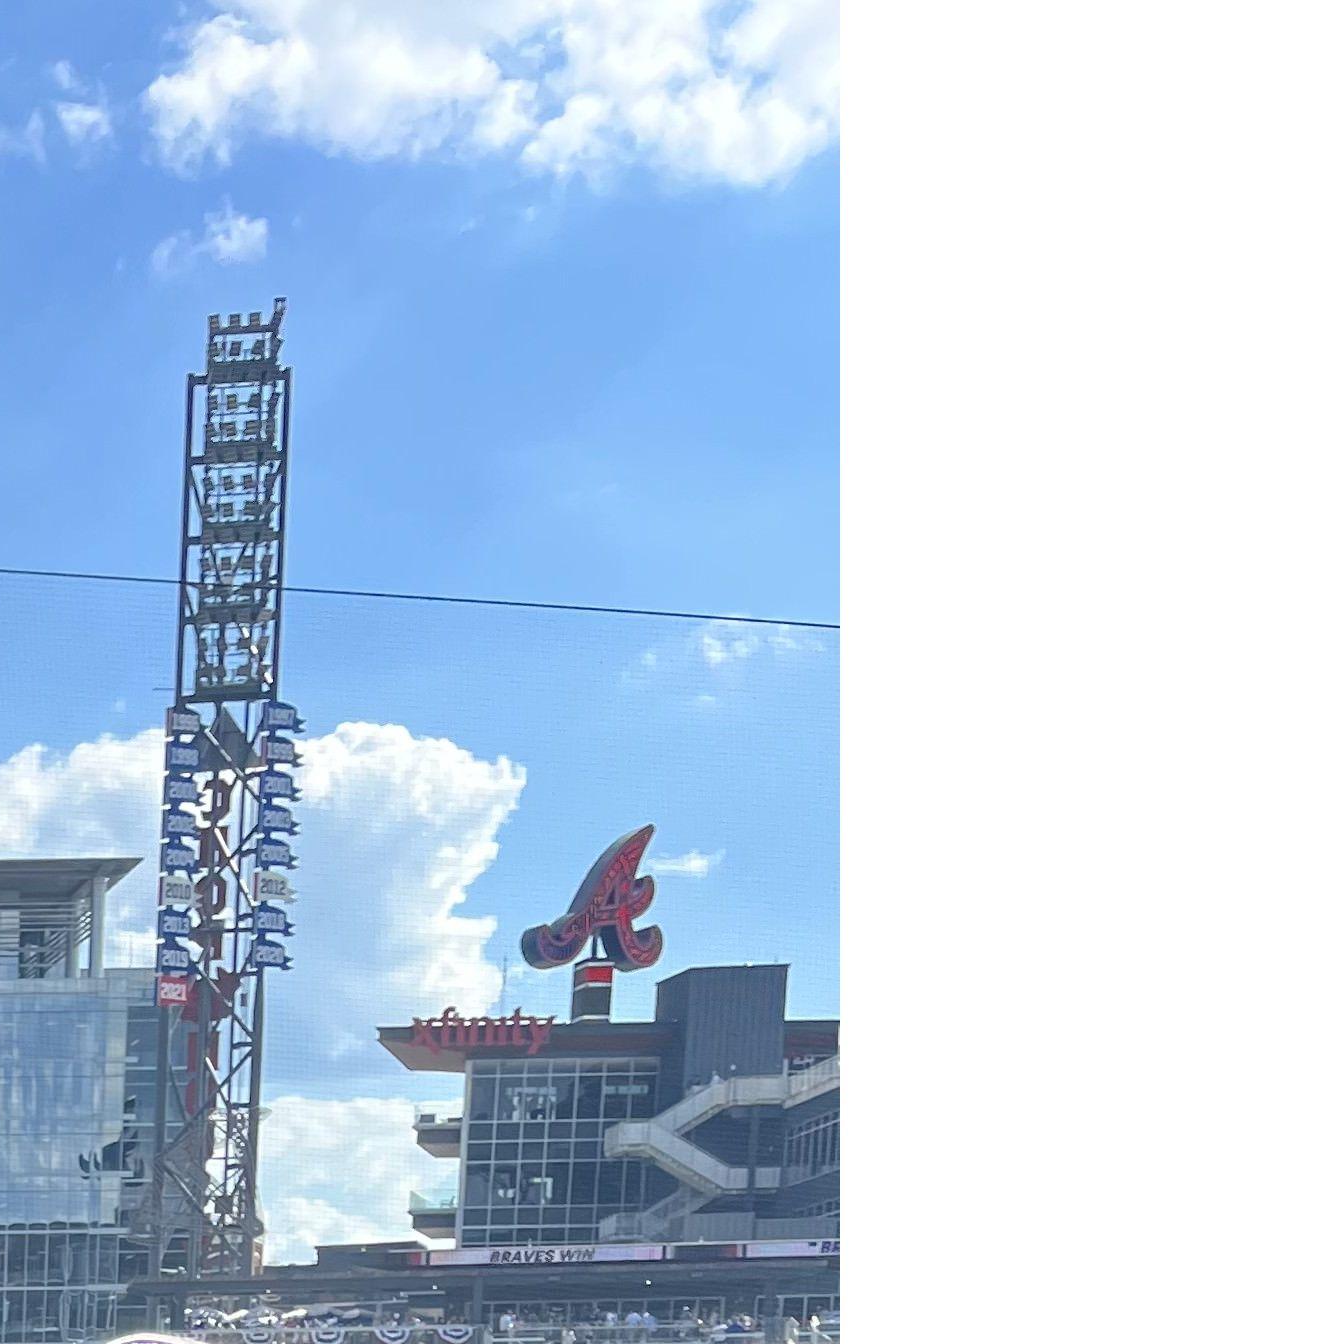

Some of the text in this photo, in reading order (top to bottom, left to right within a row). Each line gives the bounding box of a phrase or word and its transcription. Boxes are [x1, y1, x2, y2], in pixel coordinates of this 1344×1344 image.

[165, 881, 191, 900] 2010
[261, 878, 287, 896] 2012
[161, 982, 187, 1000] 2021
[411, 1006, 558, 1055] xfinity
[490, 1247, 595, 1265] BRAVES WIN
[820, 1240, 840, 1254] BR
